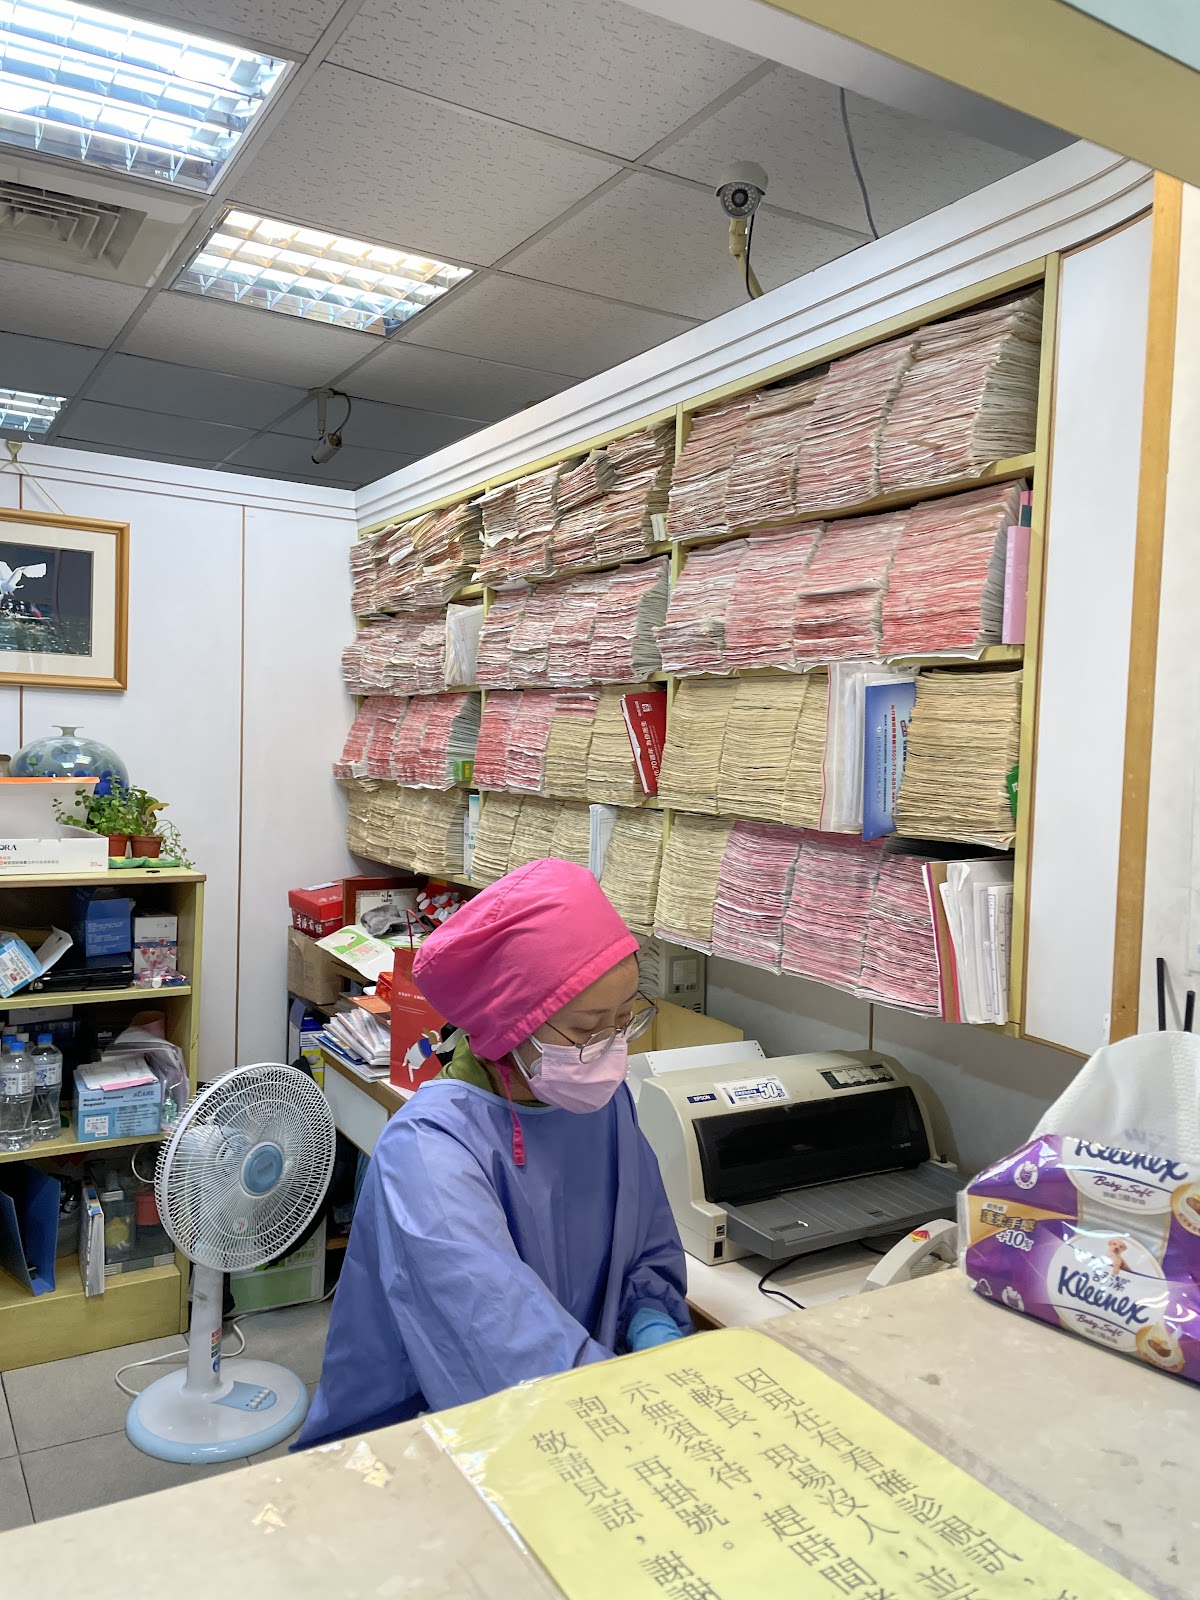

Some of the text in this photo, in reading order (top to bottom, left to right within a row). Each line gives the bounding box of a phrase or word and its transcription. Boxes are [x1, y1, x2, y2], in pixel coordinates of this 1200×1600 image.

[1074, 1140, 1189, 1183] Kleenex
[1092, 1175, 1155, 1198] Baby Soft
[1057, 1265, 1150, 1325] Kleenex
[1074, 1313, 1100, 1329] Baby
[1100, 1324, 1124, 1337] Soft
